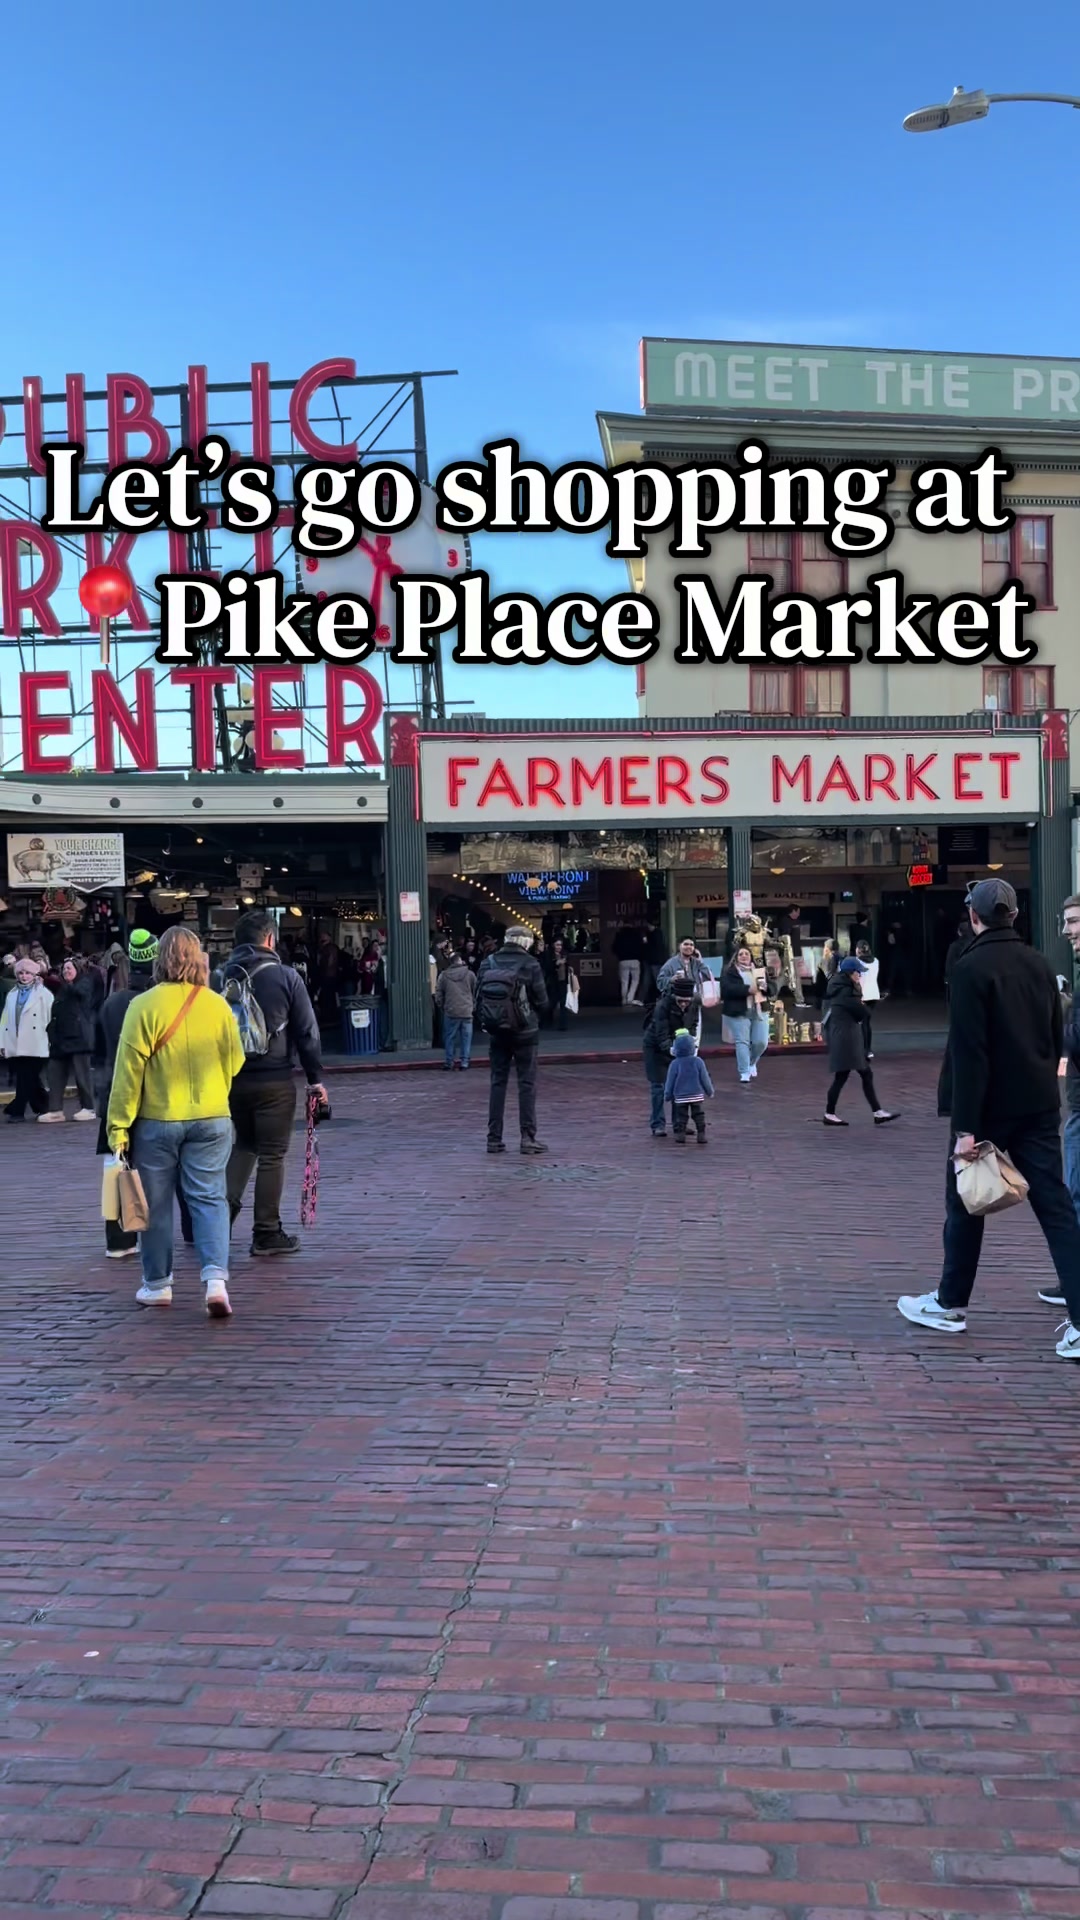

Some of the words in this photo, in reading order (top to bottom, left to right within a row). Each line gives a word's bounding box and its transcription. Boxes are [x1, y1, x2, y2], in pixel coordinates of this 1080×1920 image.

[674, 351, 829, 402] MEET
[865, 360, 970, 409] THE
[0, 357, 359, 475] UBLIC
[20, 663, 384, 773] ENTER
[448, 755, 731, 807] FARMERS
[772, 751, 1021, 803] MARKET
[696, 893, 725, 903] PIKE
